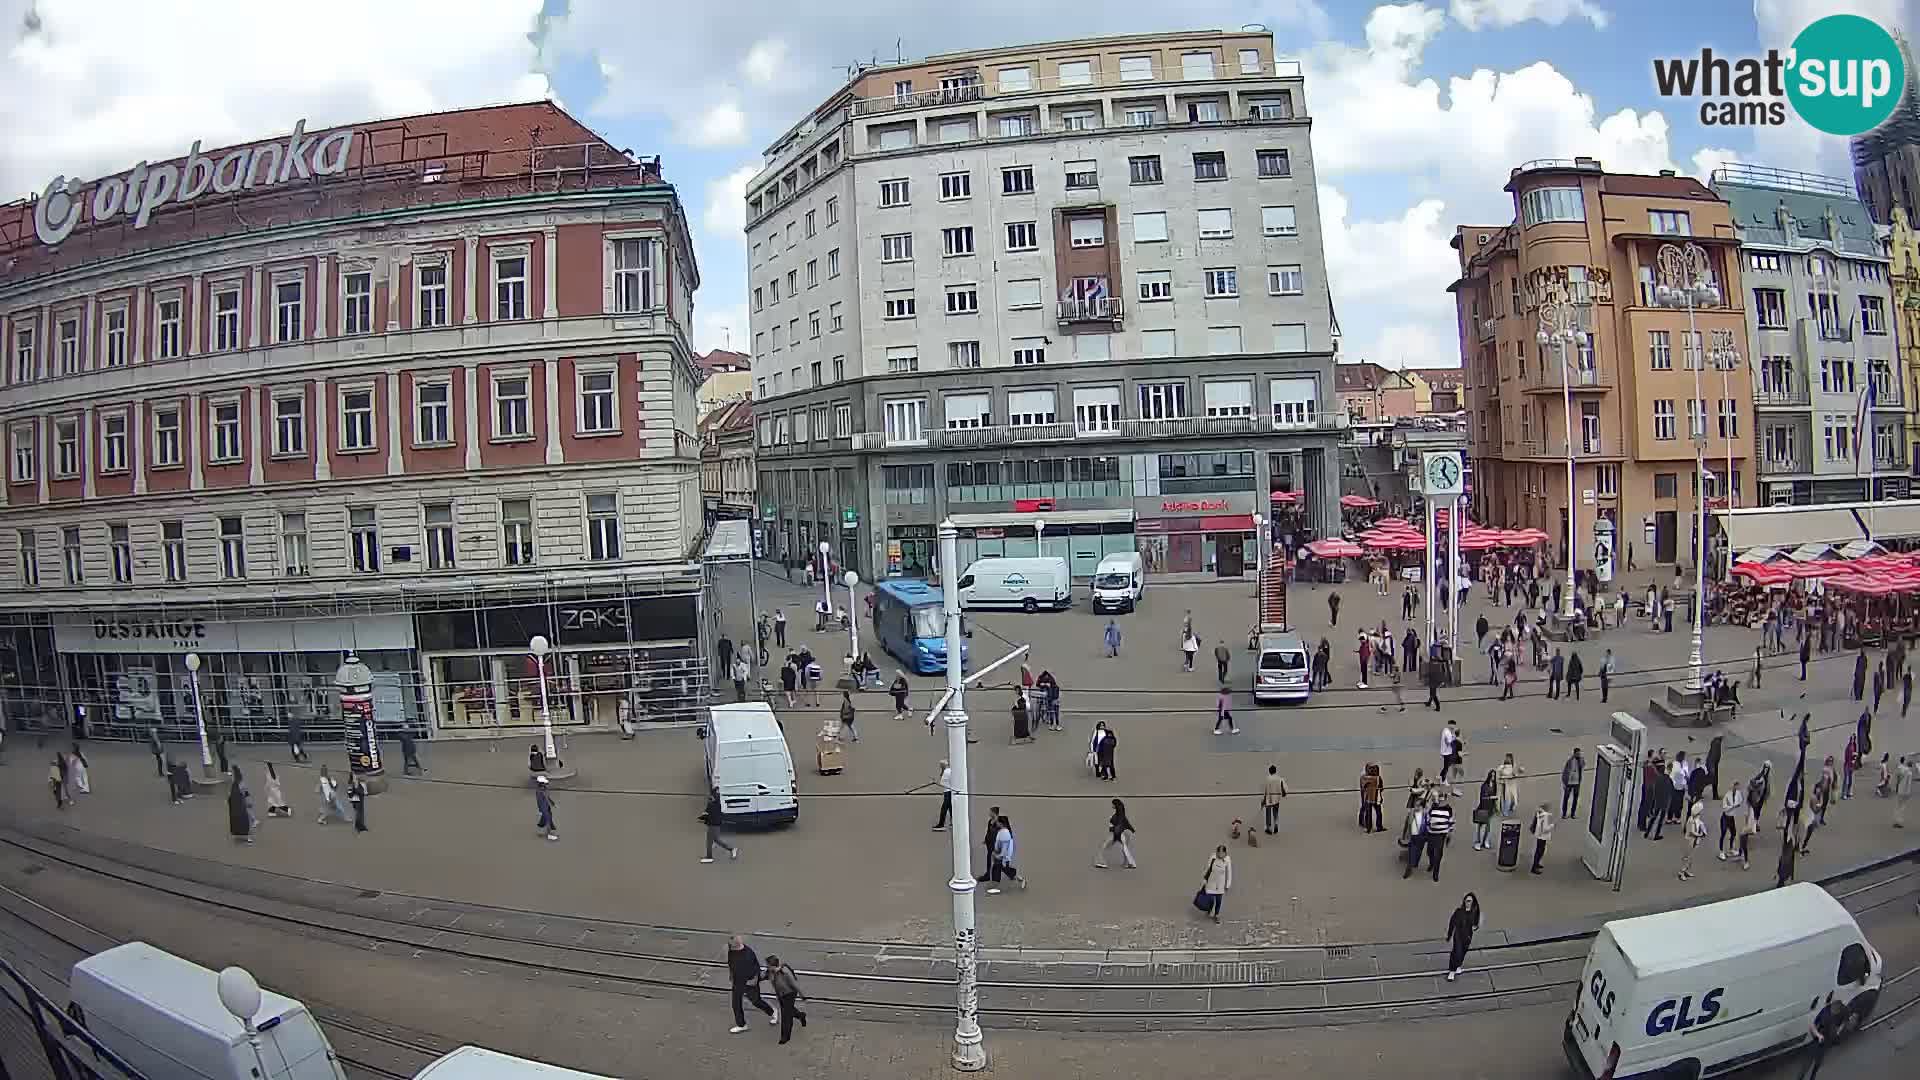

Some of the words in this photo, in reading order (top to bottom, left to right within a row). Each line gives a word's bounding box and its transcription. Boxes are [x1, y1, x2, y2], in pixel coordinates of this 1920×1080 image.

[94, 617, 206, 639] DESSANGE
[1591, 969, 1616, 1019] GLS
[1645, 987, 1725, 1037] GLS
